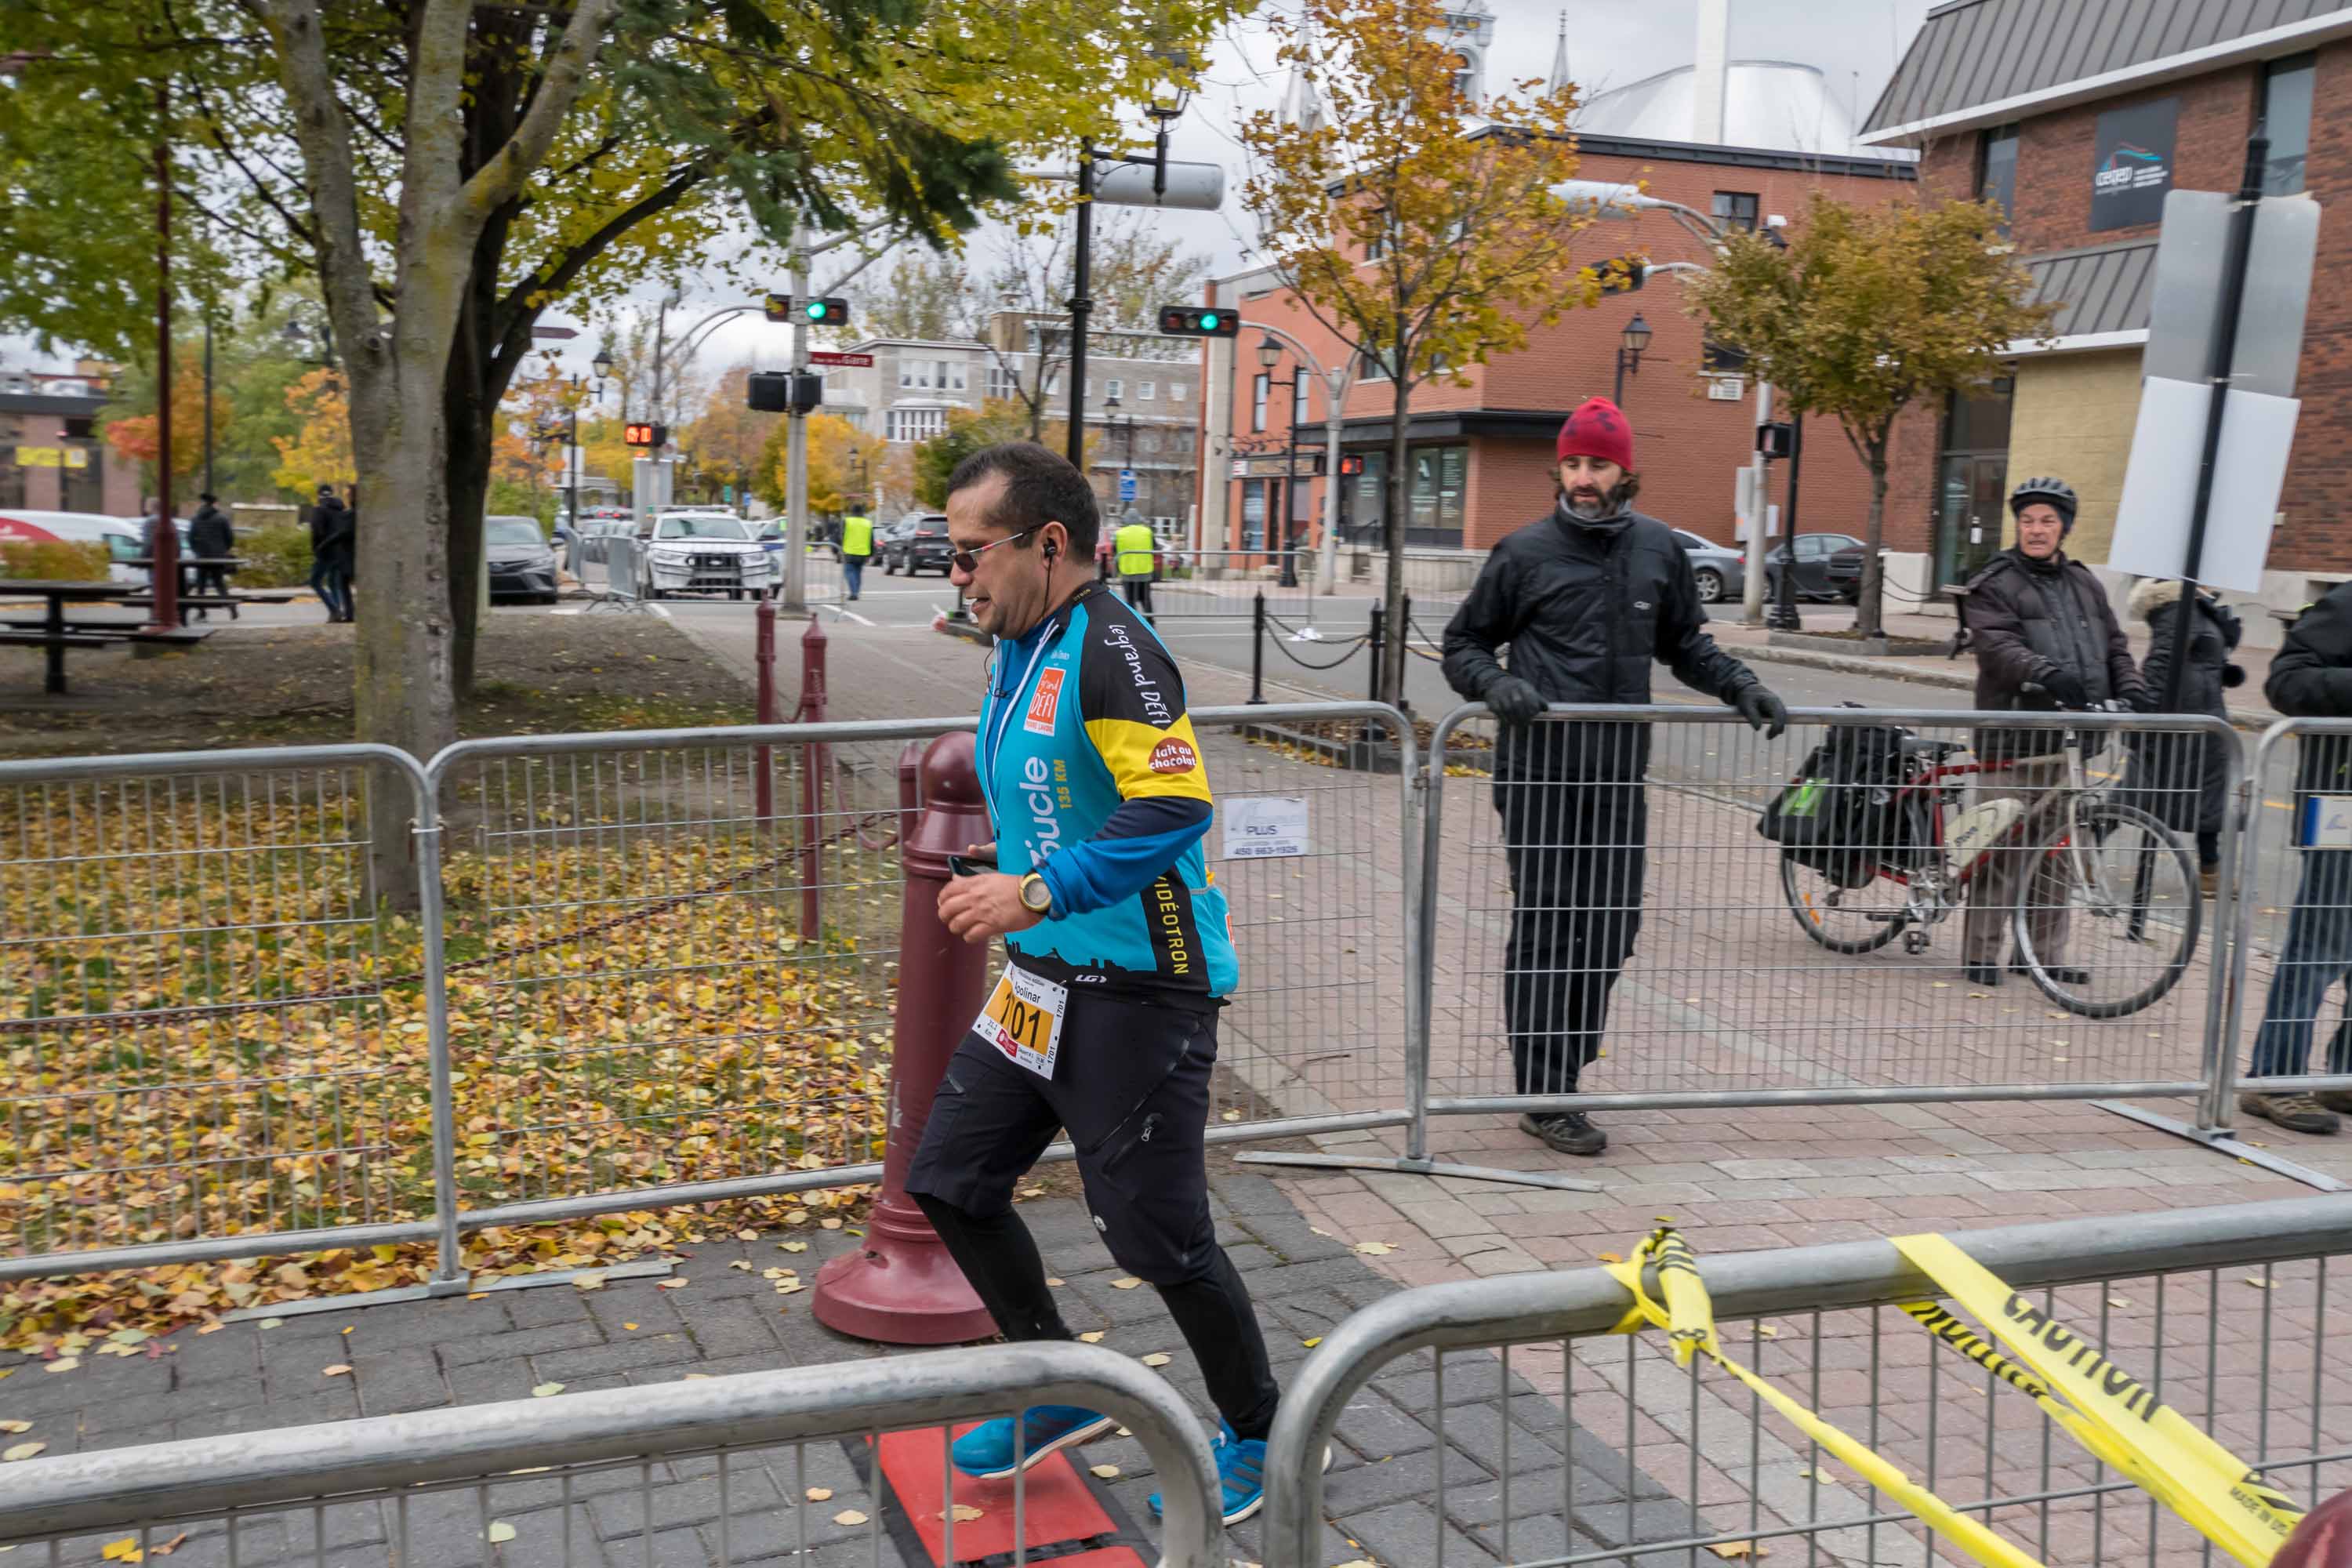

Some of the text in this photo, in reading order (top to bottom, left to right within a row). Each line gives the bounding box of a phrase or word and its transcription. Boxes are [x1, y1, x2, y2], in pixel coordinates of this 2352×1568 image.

[1156, 745, 1192, 758] lait au
[1149, 755, 1196, 770] chocolat
[1053, 759, 1073, 810] 135 KM
[1247, 825, 1278, 835] PLUS
[1056, 1000, 1065, 1018] 1701
[1047, 1046, 1056, 1065] 1701
